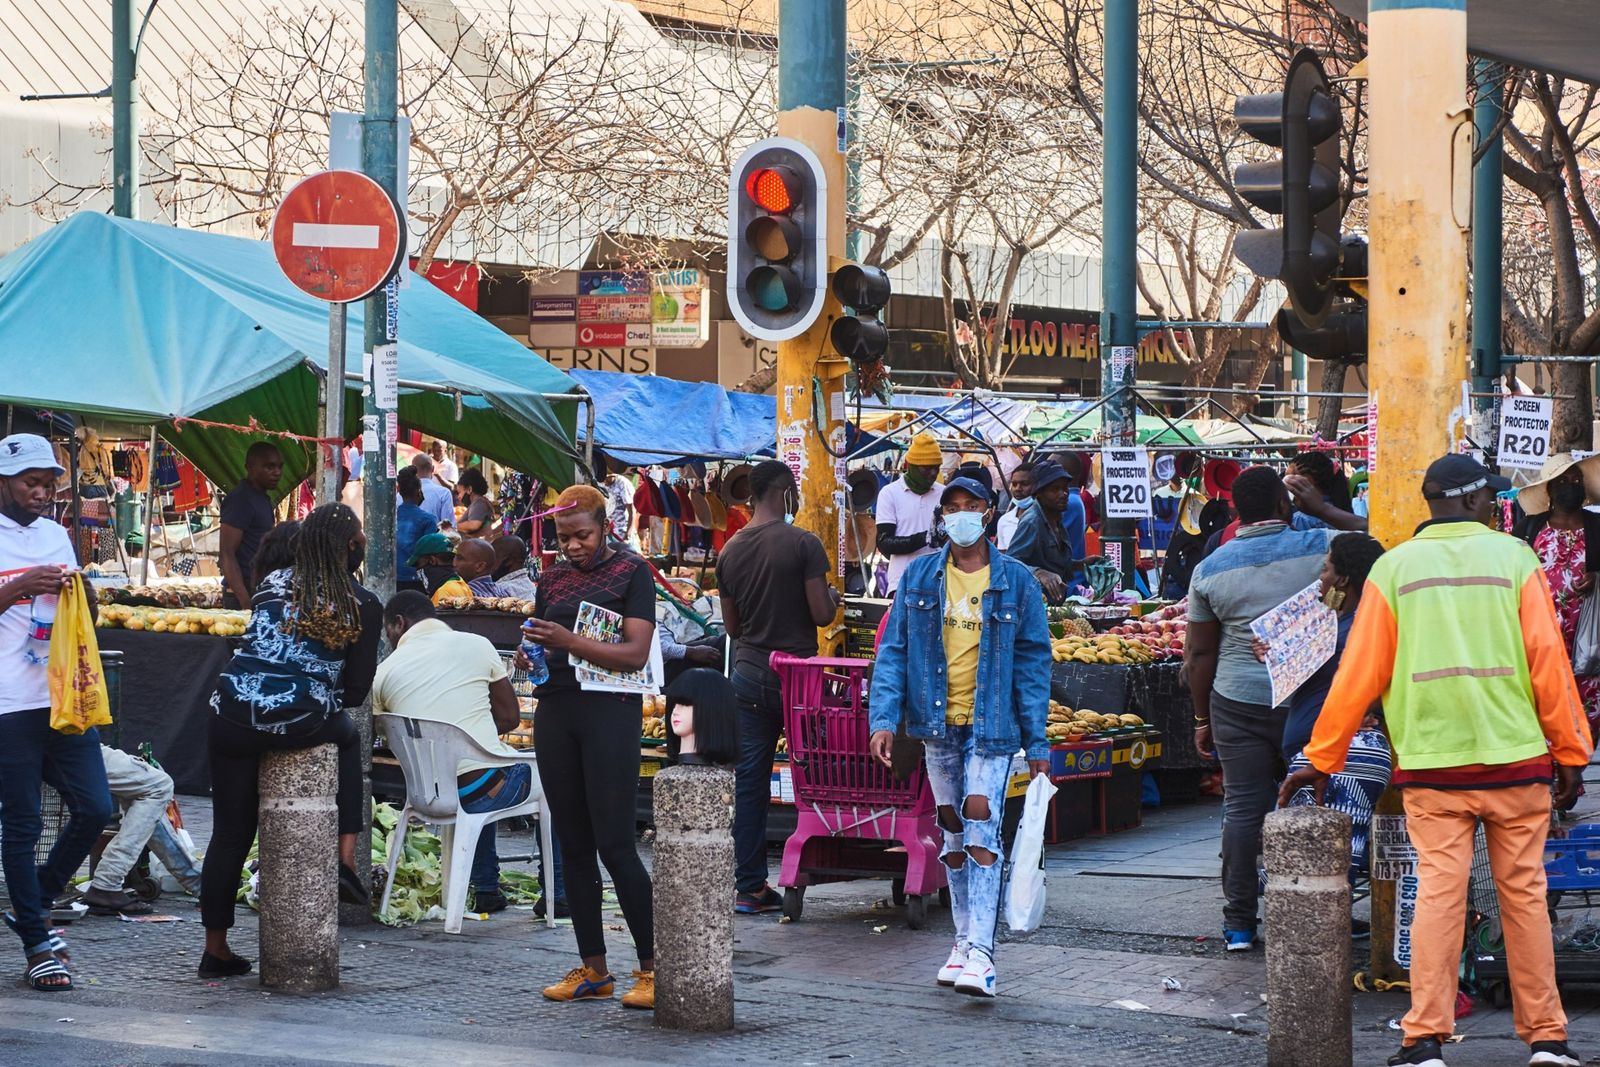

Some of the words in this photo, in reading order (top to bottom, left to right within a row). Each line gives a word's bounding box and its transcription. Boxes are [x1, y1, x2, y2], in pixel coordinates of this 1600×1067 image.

[535, 301, 573, 309] Sleepmasters
[595, 331, 624, 340] vodacom
[1113, 348, 1123, 380] ABORTION
[1513, 399, 1541, 413] SCREEN
[1504, 416, 1549, 431] PROCTECTOR
[1503, 433, 1546, 457] R20
[1111, 451, 1137, 461] SCREEN
[1106, 467, 1147, 479] PROCTECTOR
[1108, 484, 1147, 504] R20
[962, 620, 977, 631] GET
[1376, 819, 1400, 831] LOST
[1402, 876, 1418, 900] 063
